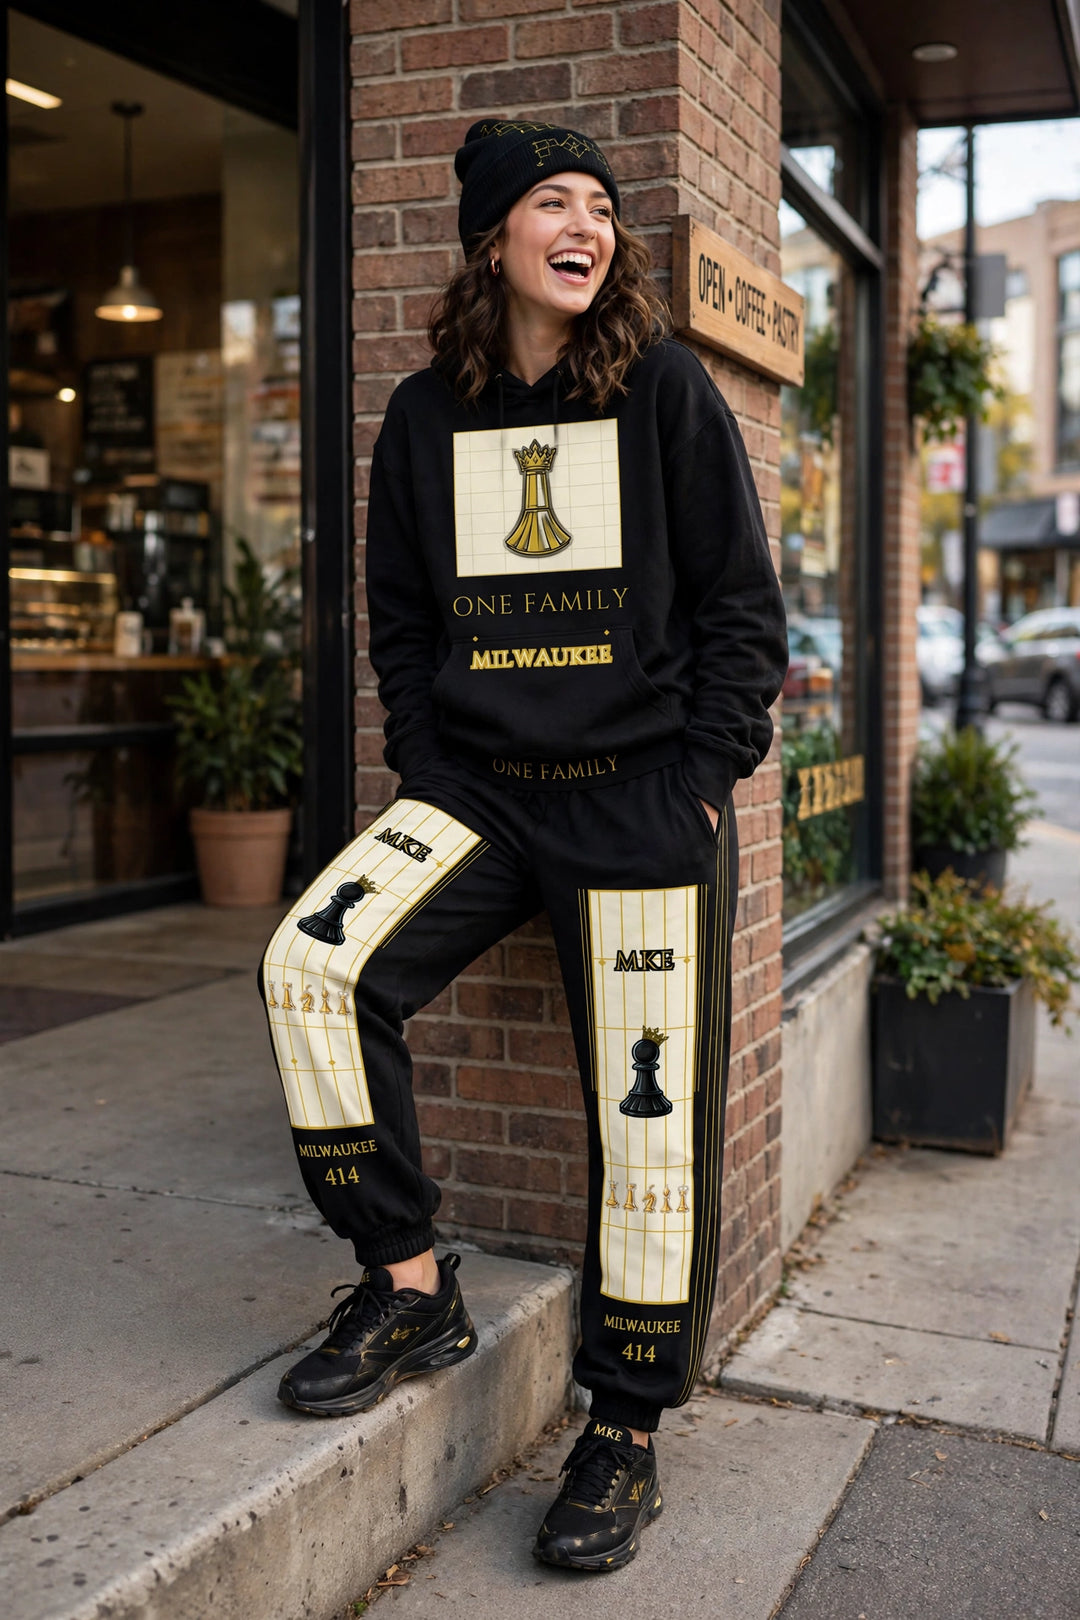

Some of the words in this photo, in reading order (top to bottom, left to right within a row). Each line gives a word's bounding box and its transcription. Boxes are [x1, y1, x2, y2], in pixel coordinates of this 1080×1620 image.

[698, 253, 726, 314] OPEN
[735, 276, 766, 336] COFFEE
[772, 300, 800, 355] PASTRY
[453, 594, 513, 617] ONE
[523, 587, 629, 614] FAMILY
[470, 643, 614, 670] MILWAUKEE
[492, 758, 533, 779] ONE
[540, 754, 619, 780] FAMILY
[374, 827, 433, 863] MKE
[613, 948, 675, 972] MKE
[299, 1139, 378, 1158] MILWAUKEE
[325, 1165, 360, 1186] 414
[603, 1313, 681, 1334] MILWAUKEE
[621, 1342, 656, 1363] 414
[593, 1423, 623, 1442] MKE
